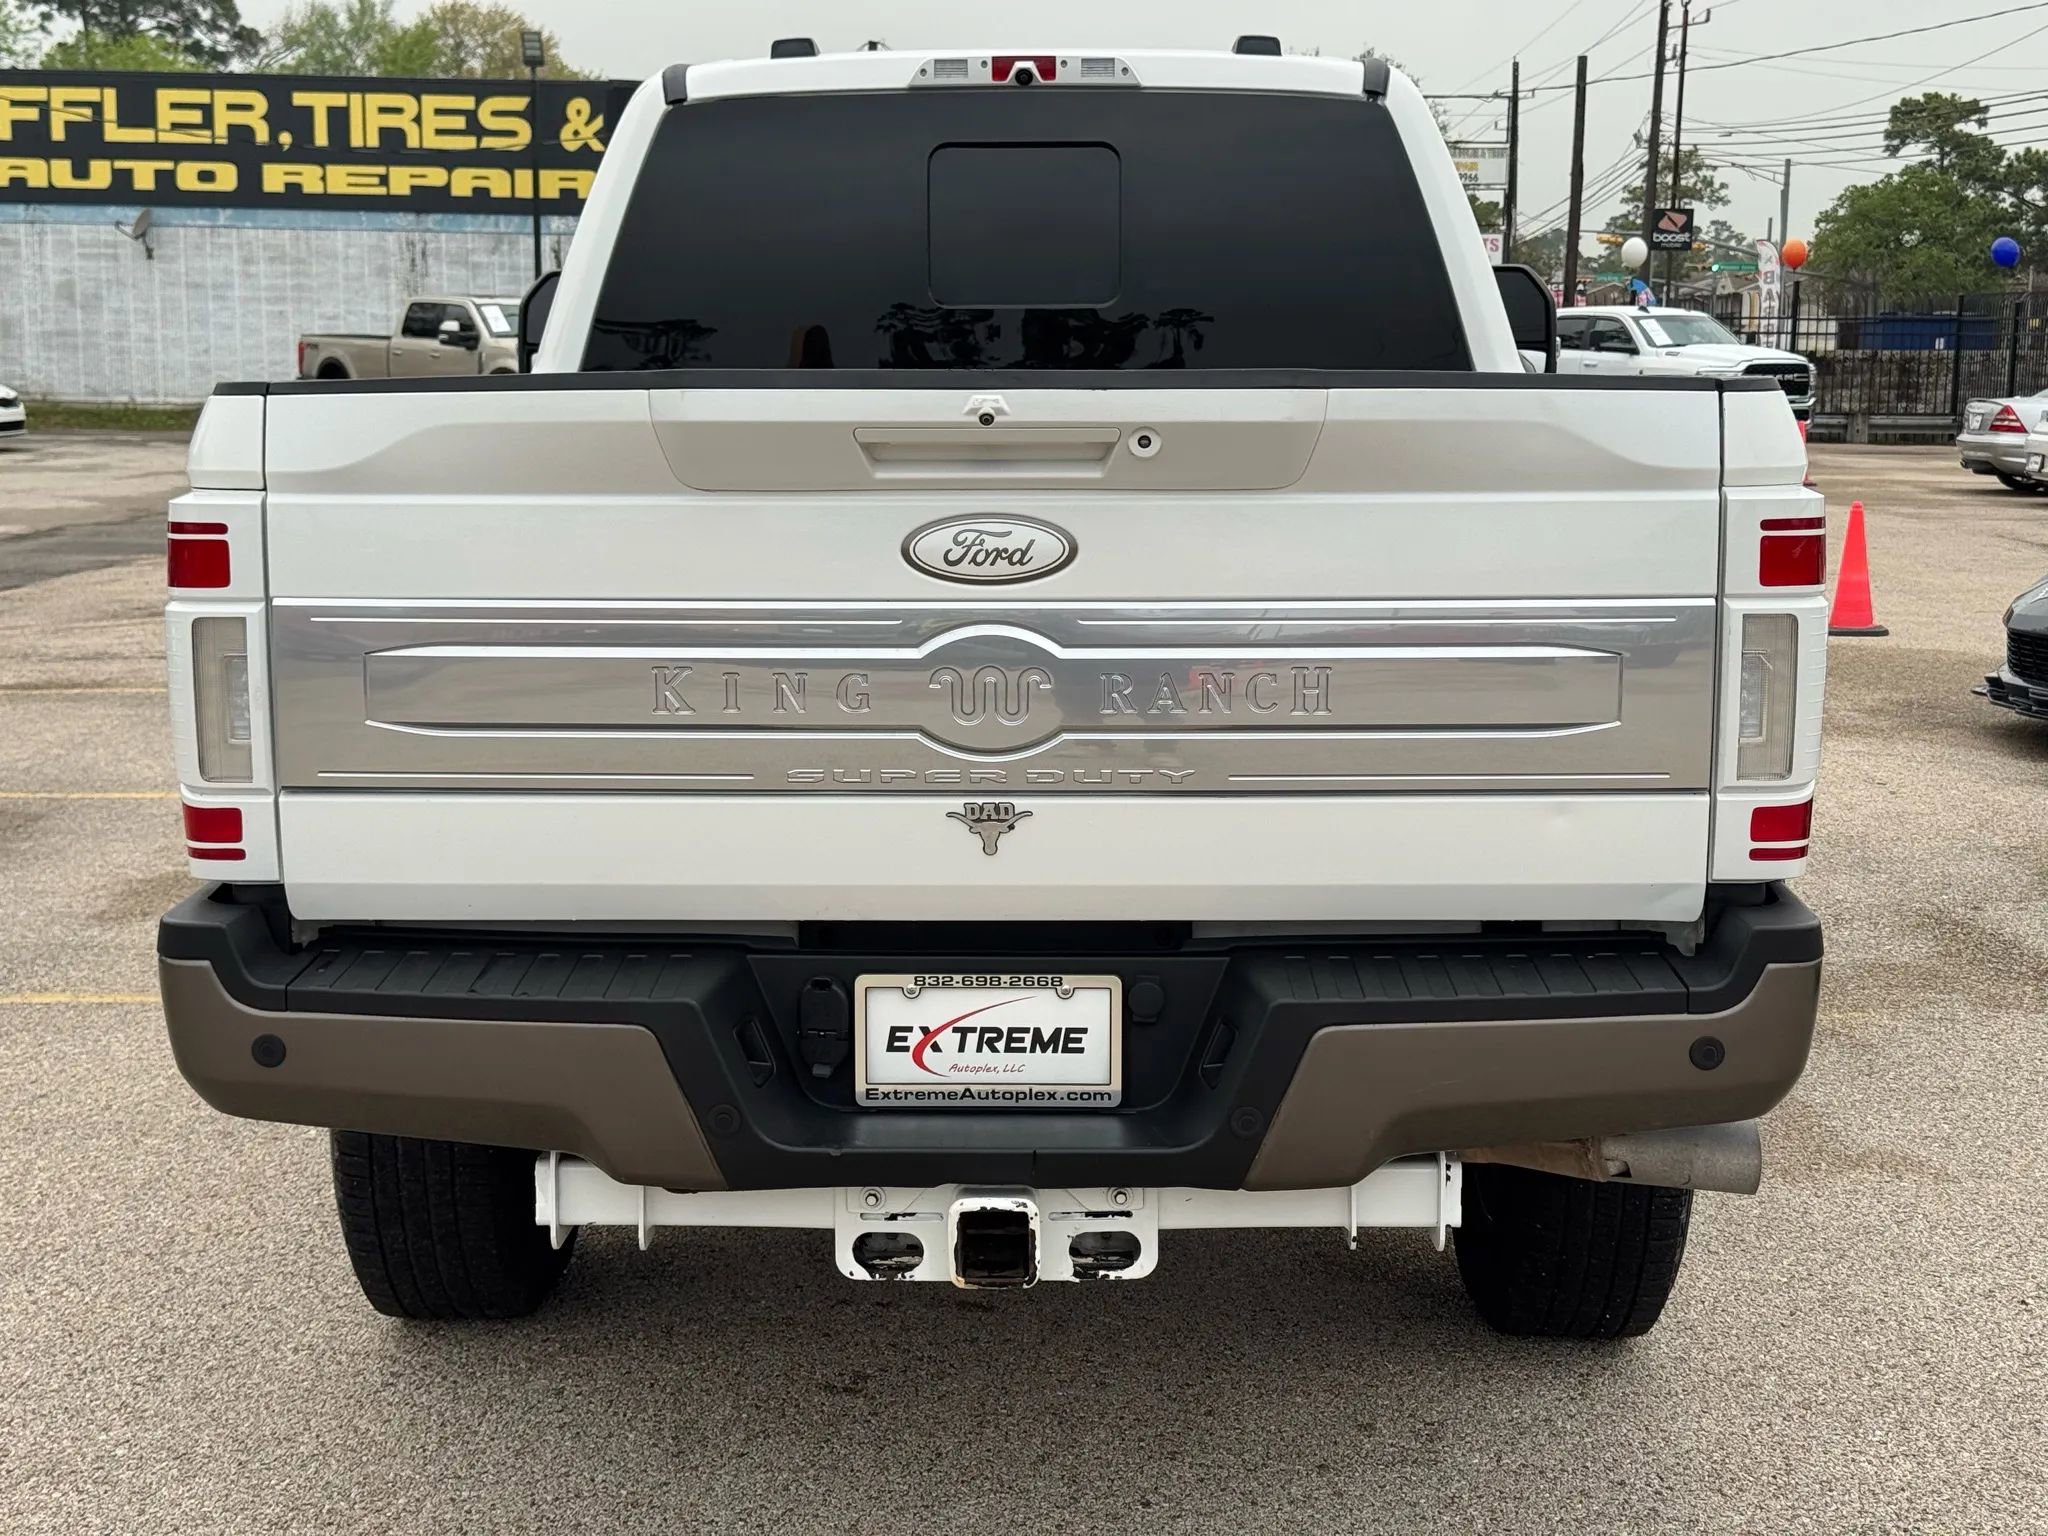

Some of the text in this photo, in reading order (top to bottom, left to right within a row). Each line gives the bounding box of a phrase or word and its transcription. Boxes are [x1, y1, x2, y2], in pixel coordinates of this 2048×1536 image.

[292, 91, 532, 151] TIRES
[560, 97, 605, 152] &
[0, 157, 597, 199] AUTO REPAIR
[1652, 231, 1690, 242] boost
[942, 527, 1036, 569] Ford
[651, 665, 1333, 716] KING RANCH
[786, 768, 1196, 785] SUPER DUTY
[963, 802, 1015, 821] DAD
[913, 975, 1064, 987] 832-698-2668
[885, 1025, 1089, 1054] EXTREME
[948, 1063, 1027, 1076] Autoplex, LLC
[864, 1086, 1113, 1104] ExtremeAutoplex.com
